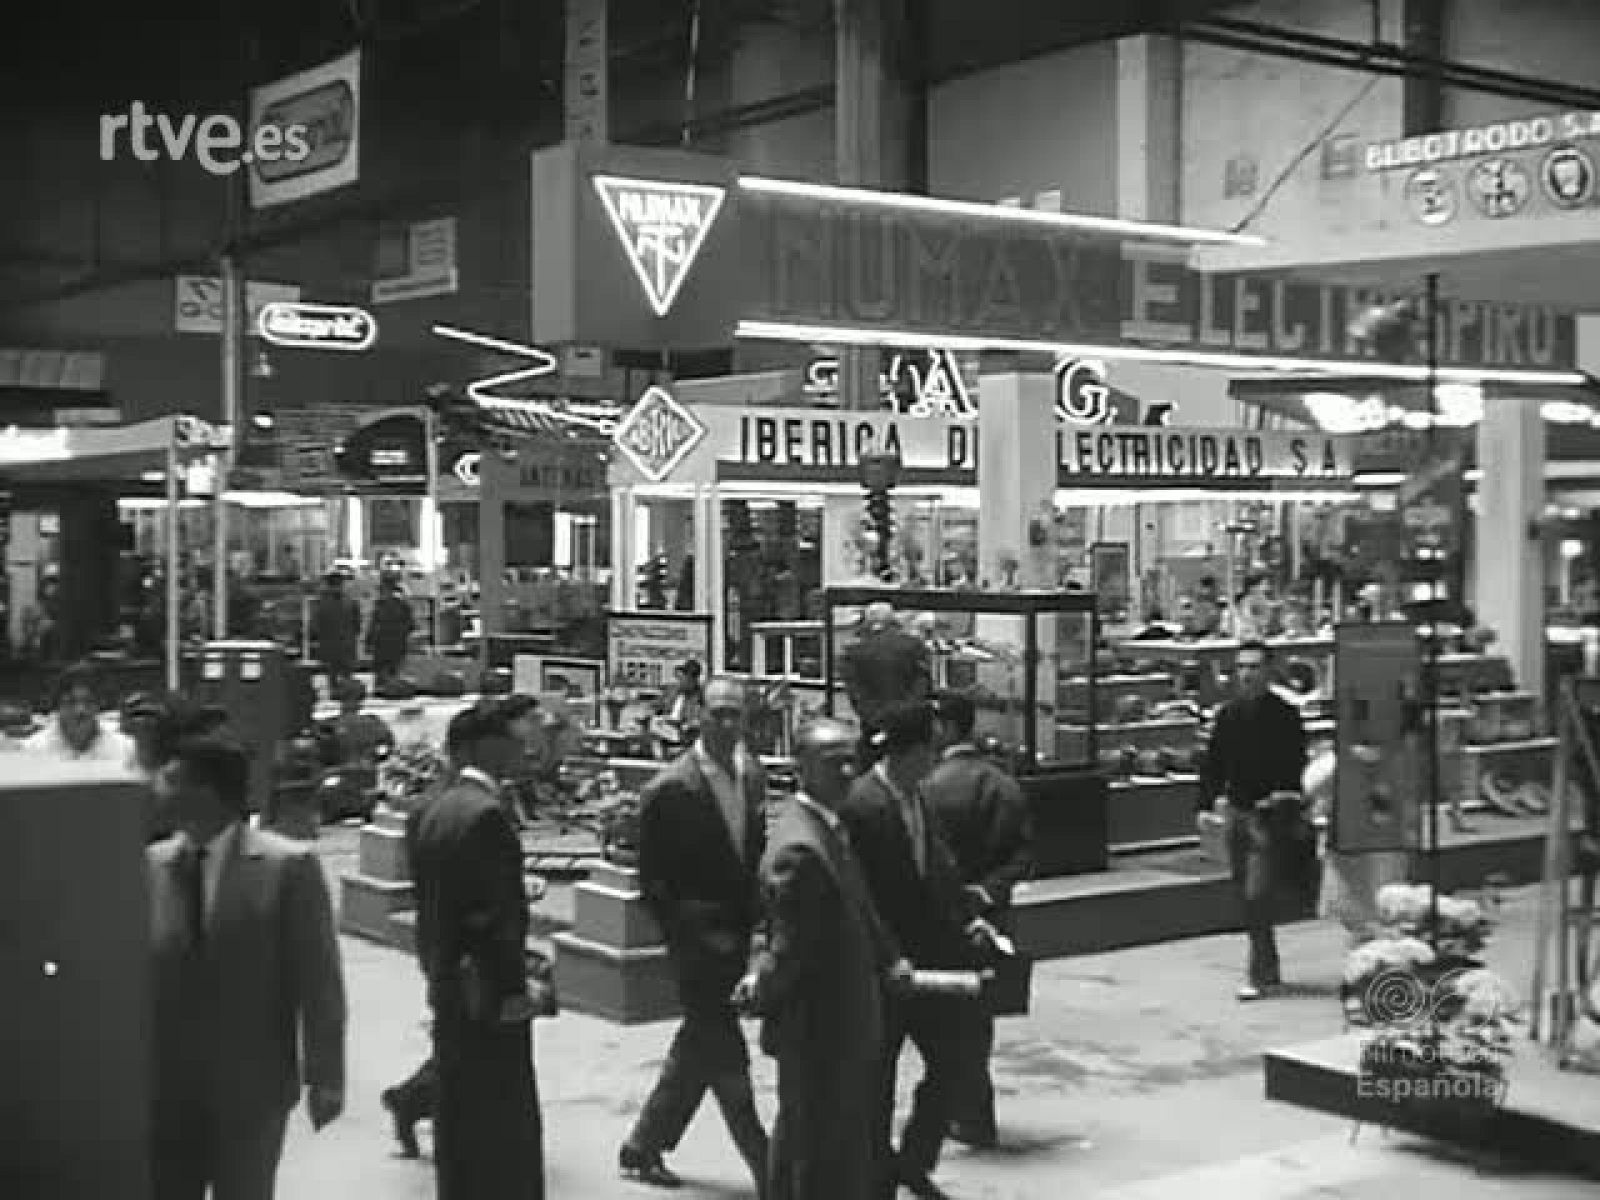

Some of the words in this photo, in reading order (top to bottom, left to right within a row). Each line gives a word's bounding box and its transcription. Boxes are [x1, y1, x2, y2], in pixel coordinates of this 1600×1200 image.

[741, 415, 902, 466] IBERICA
[948, 424, 978, 468] D
[1056, 430, 1262, 474] LECTRICIDAD
